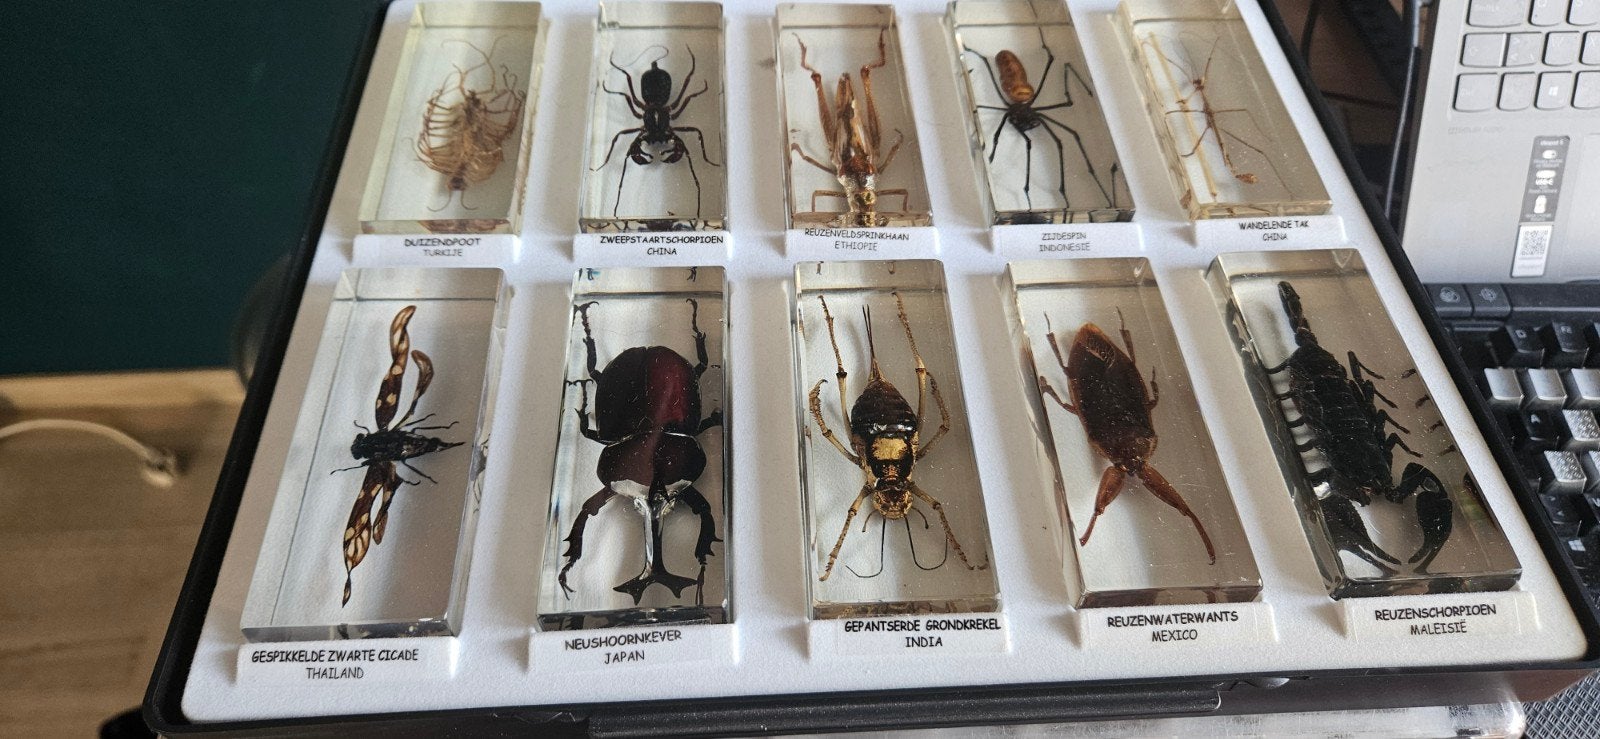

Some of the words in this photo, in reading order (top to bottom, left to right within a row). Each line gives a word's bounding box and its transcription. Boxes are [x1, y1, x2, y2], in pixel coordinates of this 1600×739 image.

[1238, 221, 1292, 231] WANDELENDE
[1295, 220, 1309, 228] TAK
[600, 235, 724, 244] ZWEEPSTAARTSCHORPIOEN
[804, 228, 910, 241] REUZENVELDSPRINKHAAN
[1041, 232, 1087, 241] ZIJDESPIN
[1262, 232, 1288, 242] CHINA
[404, 238, 480, 247] DUIZENDPOOT
[834, 240, 878, 251] ETHIOPIE
[423, 248, 463, 257] TURKIJE
[646, 247, 678, 256] CHINA
[1374, 604, 1497, 621] REUZENSCHORPIOEN
[844, 620, 921, 632] GEPANTSERDE
[925, 618, 1001, 631] GRONDKREKEL
[1107, 611, 1239, 627] REUZENWATERWANTS
[1410, 619, 1468, 636] MALEISIË
[565, 630, 682, 650] NEUSHOORNKEVER
[1151, 629, 1198, 642] MEXICO
[905, 637, 943, 648] INDIA
[251, 650, 325, 663] GESPIKKELDE
[328, 650, 375, 662] ZWARTE
[378, 649, 419, 661] CICADE
[604, 650, 645, 664] JAPAN
[306, 667, 364, 679] THAILAND
